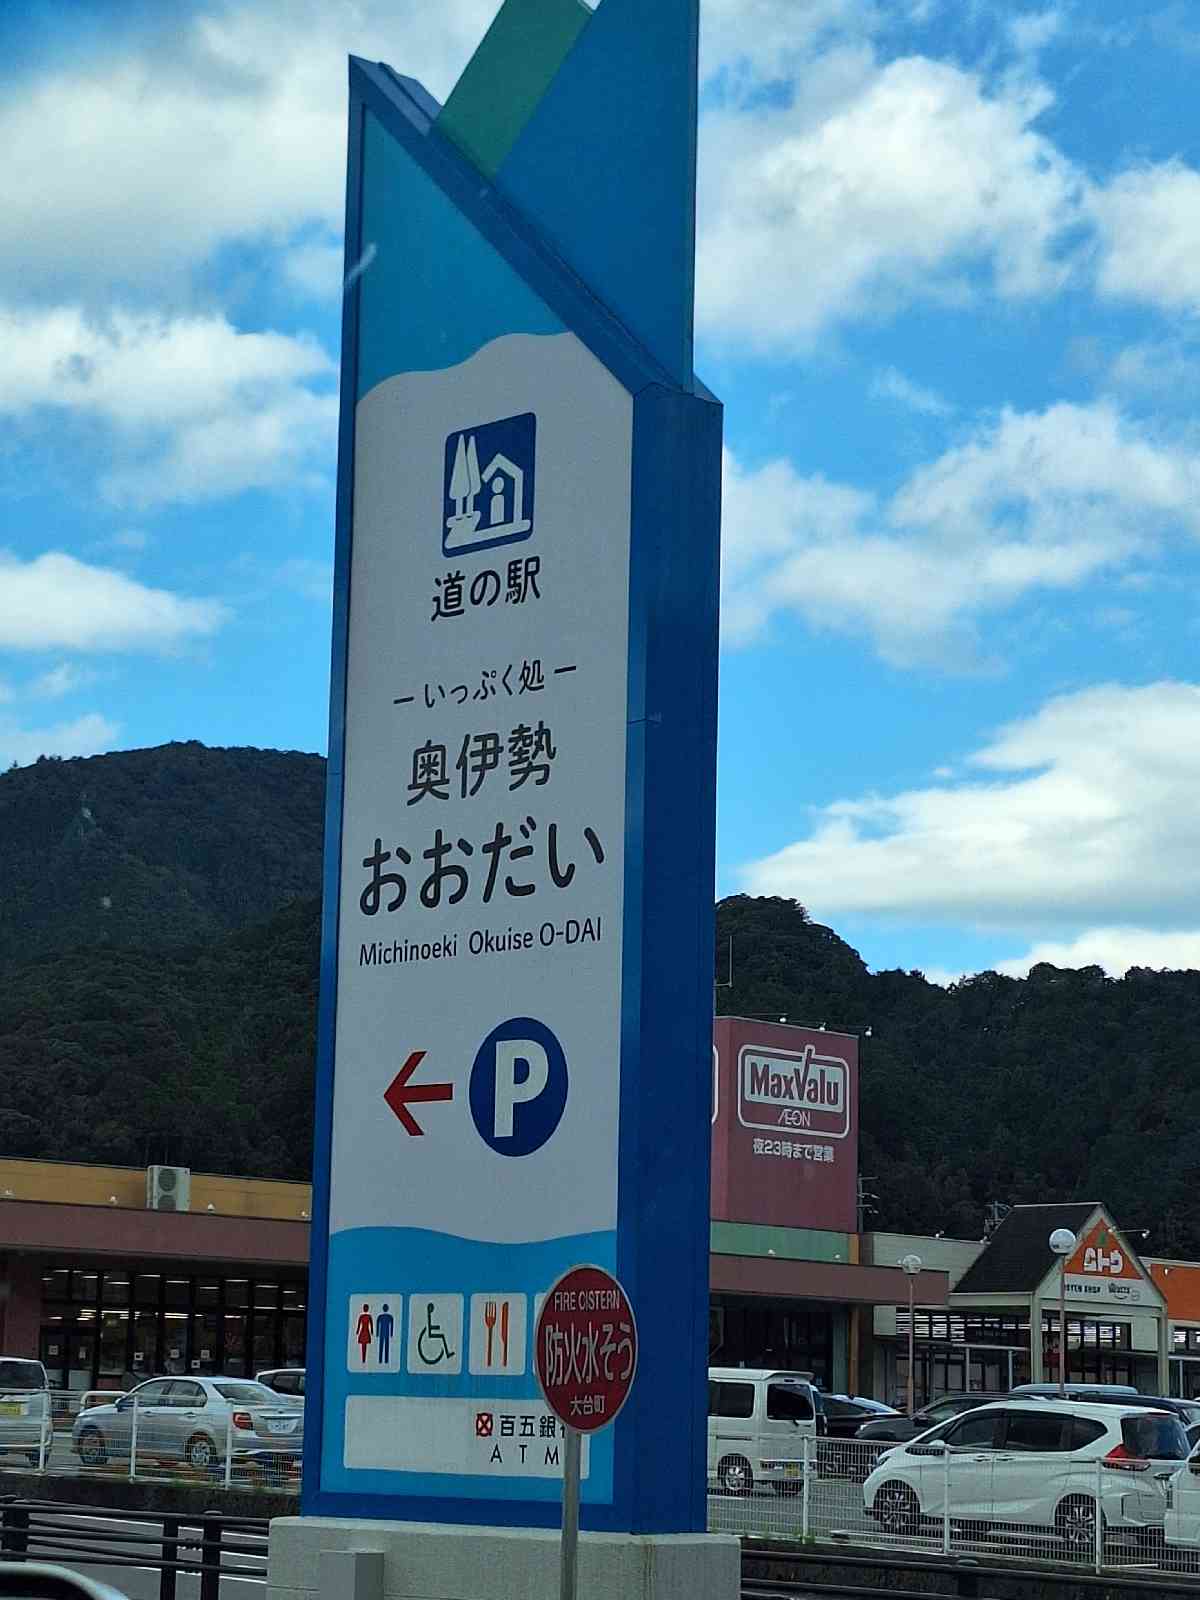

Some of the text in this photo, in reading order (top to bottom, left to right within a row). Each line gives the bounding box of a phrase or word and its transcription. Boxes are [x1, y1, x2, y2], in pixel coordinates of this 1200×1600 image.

[431, 556, 541, 622] 道の駅
[407, 720, 557, 806] 奥伊勢
[359, 815, 605, 916] おおだい
[359, 917, 602, 967] Michinoeki Okuise O-DAI
[494, 1038, 549, 1138] P
[750, 1049, 839, 1106] MaxValu
[554, 1289, 620, 1312] FIRE CISTERN
[545, 1320, 633, 1387] 防火水そう
[570, 1394, 606, 1416] 大台町
